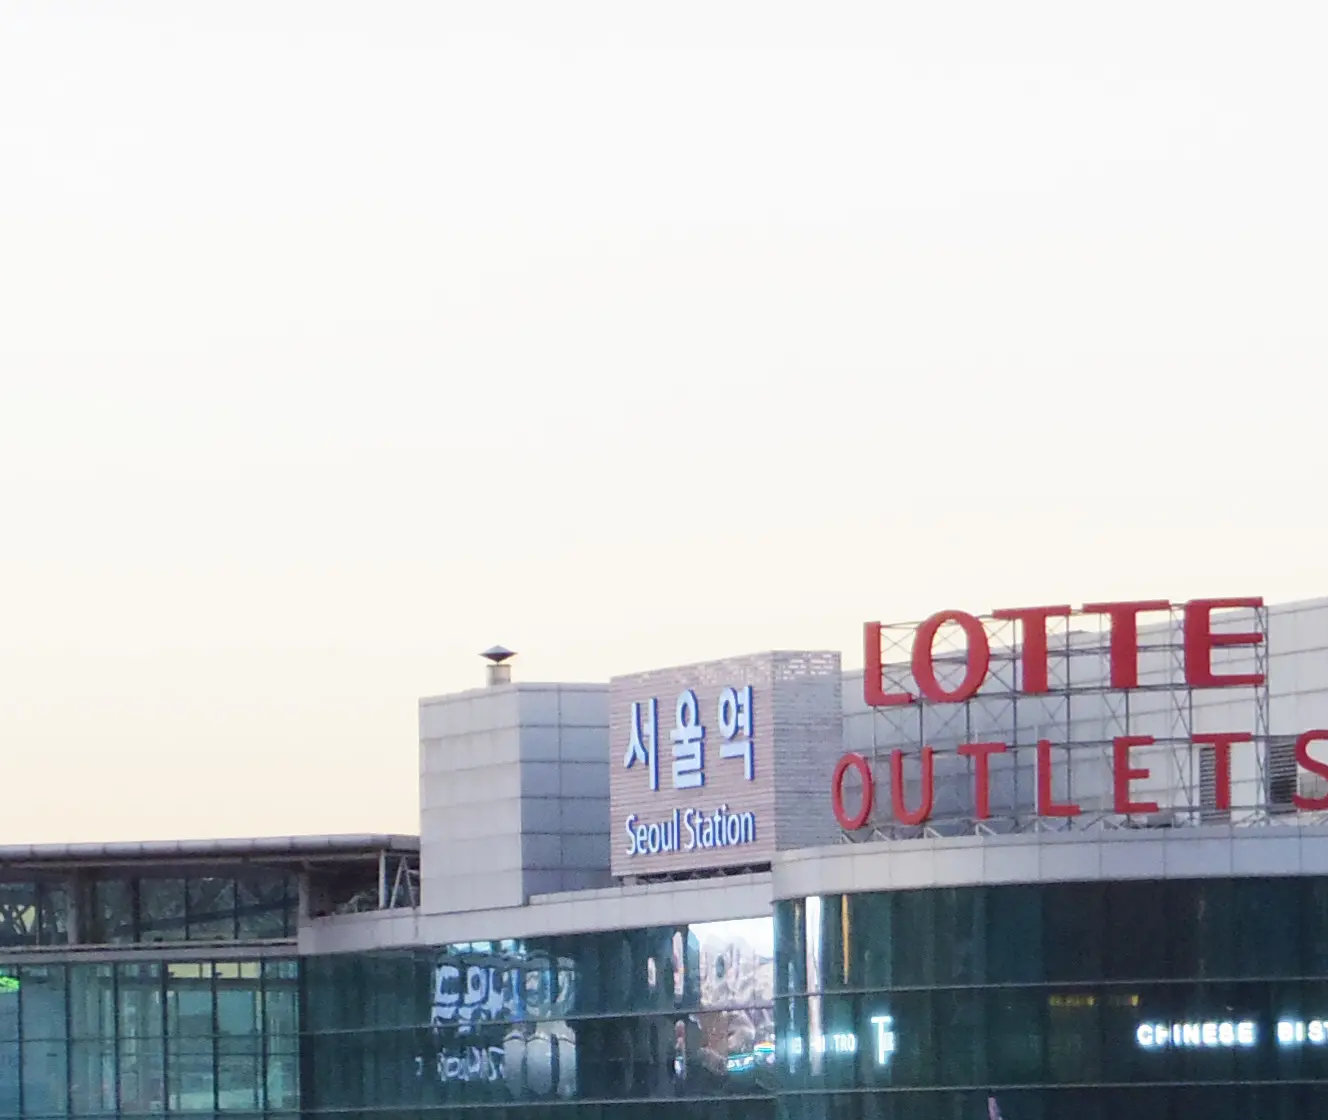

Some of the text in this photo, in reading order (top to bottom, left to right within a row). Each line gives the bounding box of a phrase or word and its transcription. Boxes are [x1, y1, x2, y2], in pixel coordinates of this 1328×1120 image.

[863, 597, 1265, 706] LOTTE
[624, 685, 755, 792] 서울역
[625, 804, 756, 856] Seoul Station
[1136, 1021, 1257, 1046] CHINESE
